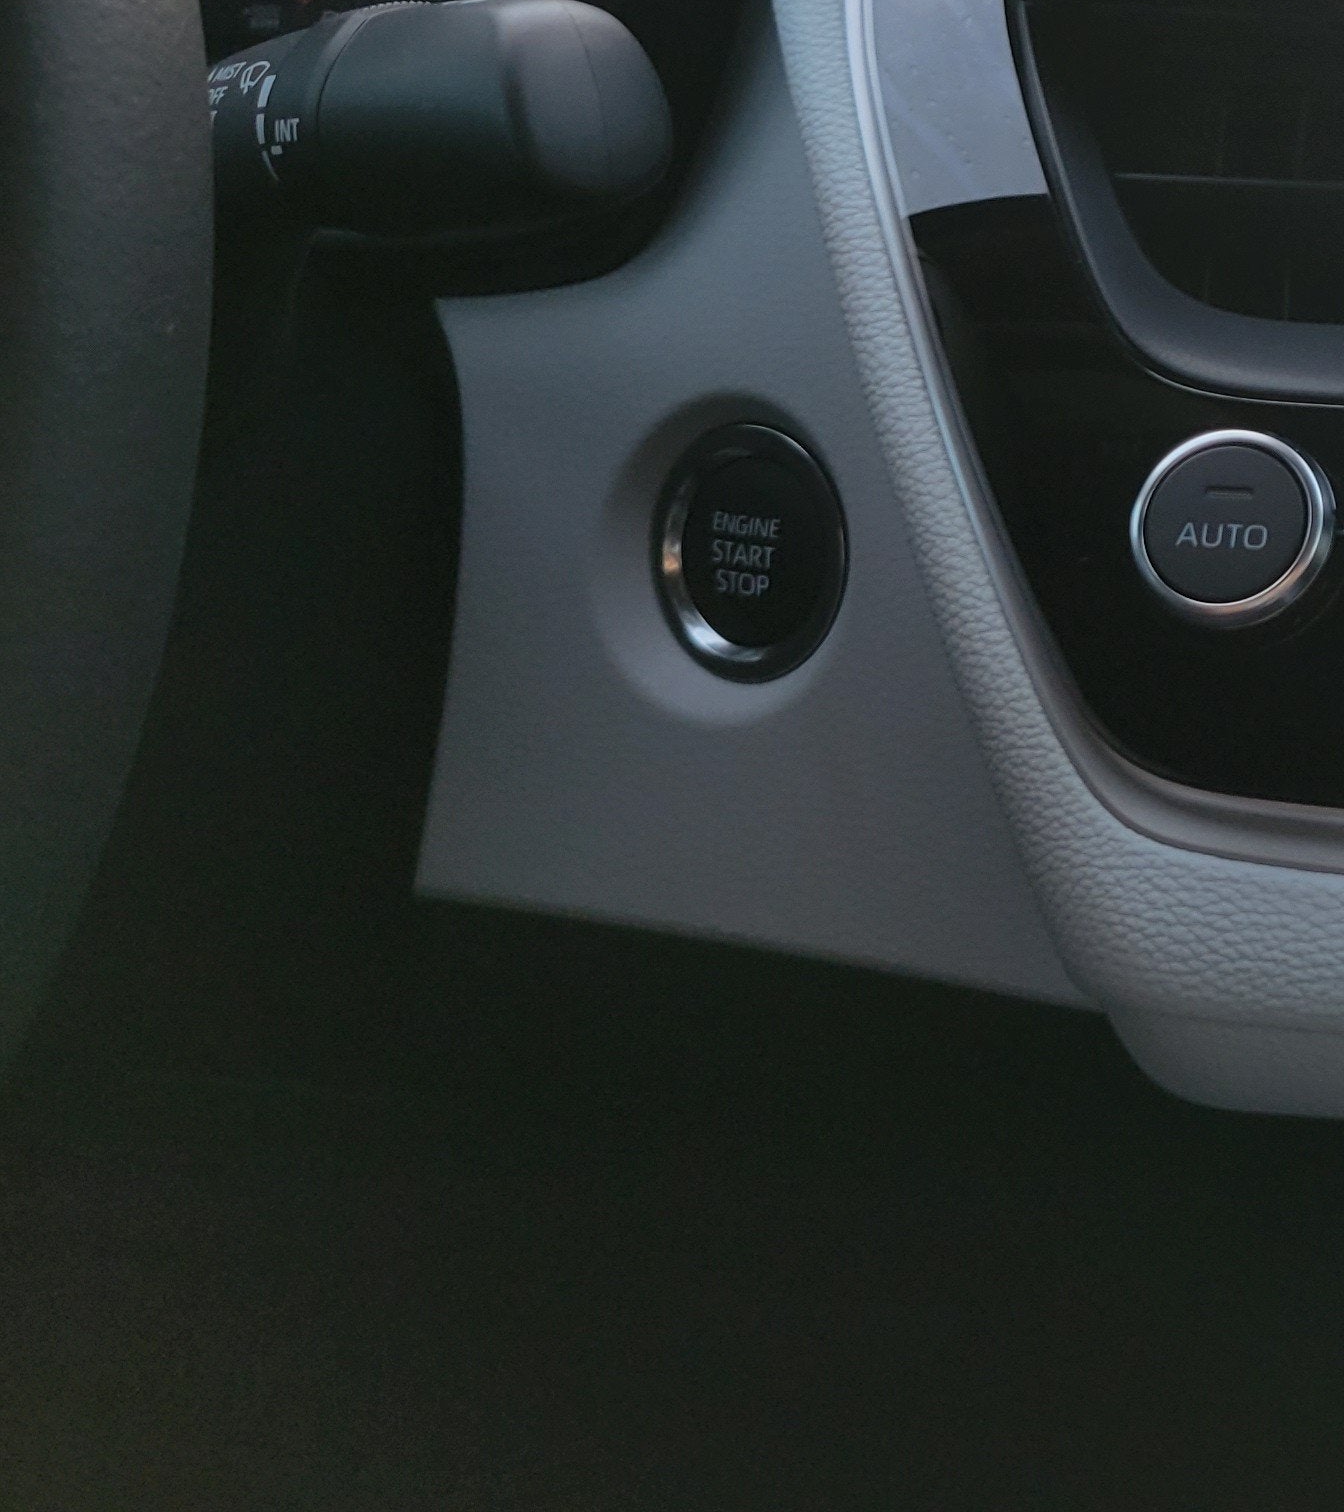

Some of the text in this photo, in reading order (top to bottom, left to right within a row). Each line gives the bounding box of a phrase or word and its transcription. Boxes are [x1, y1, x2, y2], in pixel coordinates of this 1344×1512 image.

[208, 86, 229, 105] FF
[275, 117, 300, 143] INT
[712, 510, 782, 538] ENGINE
[1175, 521, 1269, 551] AUTO
[711, 539, 777, 569] START
[715, 568, 770, 597] STOP
